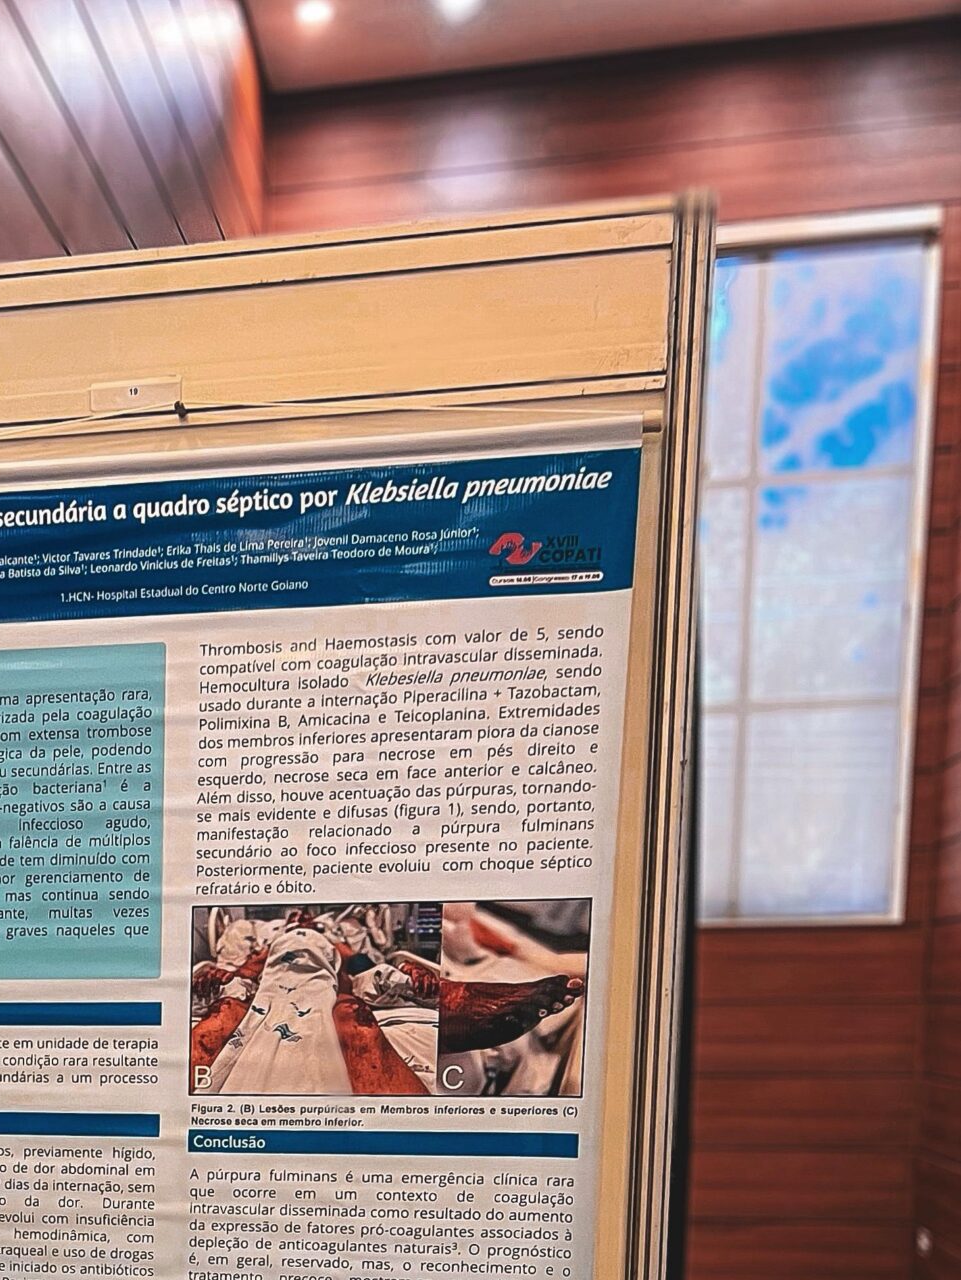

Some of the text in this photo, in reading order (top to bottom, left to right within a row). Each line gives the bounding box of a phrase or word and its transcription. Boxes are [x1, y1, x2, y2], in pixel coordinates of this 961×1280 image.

[113, 504, 126, 520] a
[133, 494, 210, 524] quadro
[216, 488, 293, 518] séptico
[300, 490, 338, 514] por
[345, 476, 459, 505] Klebsiella
[462, 466, 612, 504] pneumoniae
[42, 554, 70, 563] Victor
[73, 551, 110, 561] Tavares
[167, 545, 191, 556] Erika
[224, 542, 236, 552] de
[312, 534, 348, 549] Jovenil
[352, 534, 408, 544] Damaceno
[412, 530, 437, 540] Rosa
[546, 535, 579, 546] XVIII
[8, 568, 41, 578] Batista
[44, 566, 56, 576] da
[90, 561, 138, 574] Leonardo
[181, 558, 194, 568] de
[241, 553, 289, 565] Thamillys
[292, 549, 328, 561] Taveira
[331, 548, 375, 559] Teodoro
[378, 546, 392, 556] de
[539, 547, 602, 563] COPATI
[61, 580, 308, 602] 1.HCN- Hospital Estadual do Centro Norte Goiano
[200, 624, 604, 656] Thrombosis and Haemostasis com valor de 5, sendo
[26, 689, 115, 708] apresentação
[122, 690, 152, 701] rara,
[42, 709, 69, 726] pela
[77, 706, 152, 723] coagulação
[70, 799, 93, 811] são
[99, 801, 106, 810] a
[113, 800, 150, 810] causa
[14, 1040, 33, 1049] em
[37, 1037, 89, 1049] unidade
[93, 1037, 108, 1049] de
[113, 1038, 158, 1052] terapia
[194, 1066, 212, 1088] B
[442, 1066, 464, 1089] C
[192, 1104, 222, 1114] Figura
[227, 1104, 235, 1112] 2.
[240, 1104, 254, 1115] (B)
[259, 1105, 295, 1113] Lesões
[300, 1106, 356, 1115] purpúricas
[380, 1105, 429, 1114] Membros
[434, 1106, 485, 1114] inferiores
[501, 1106, 558, 1116] superiores
[563, 1106, 578, 1118] (C)
[191, 1116, 232, 1125] Necrose
[279, 1118, 321, 1126] membro
[325, 1118, 364, 1126] inferior.
[194, 1135, 266, 1148] Conclusão
[24, 1146, 102, 1160] previamente
[113, 1147, 155, 1162] hígido,
[190, 1168, 574, 1188] A púrpura fulminans é uma emergência clínica rara
